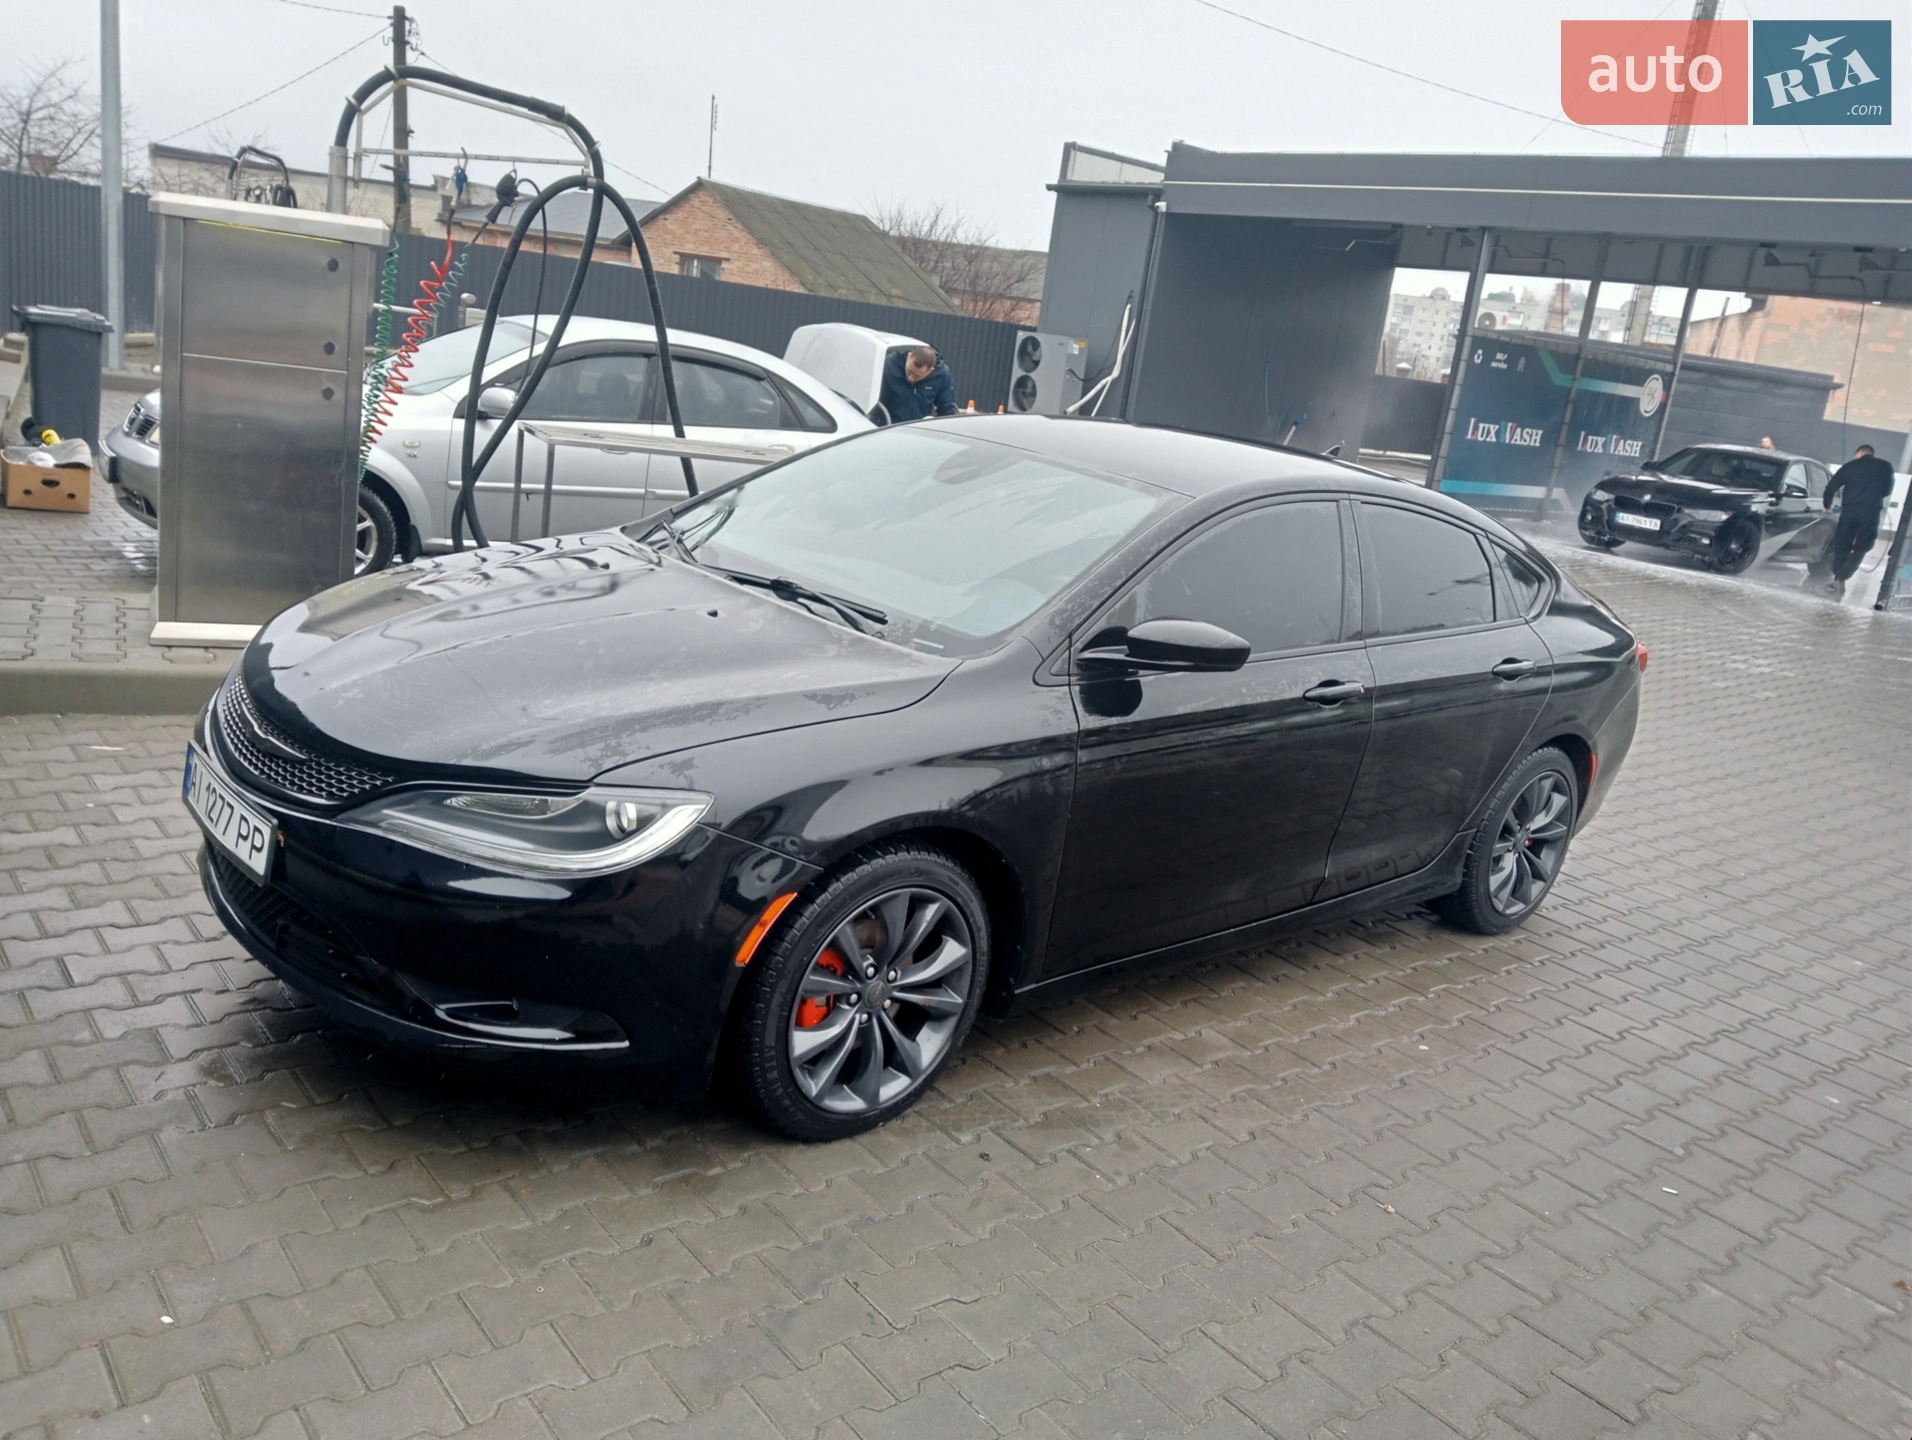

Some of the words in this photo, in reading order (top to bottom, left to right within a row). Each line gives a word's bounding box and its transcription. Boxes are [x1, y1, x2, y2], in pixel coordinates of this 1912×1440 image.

[1466, 417, 1499, 443] LUX
[1500, 420, 1544, 447] WASH
[1577, 430, 1606, 453] LUX
[1607, 433, 1643, 457] WASH
[190, 761, 204, 804] AI
[205, 781, 235, 837] 1277
[235, 811, 265, 861] PP
